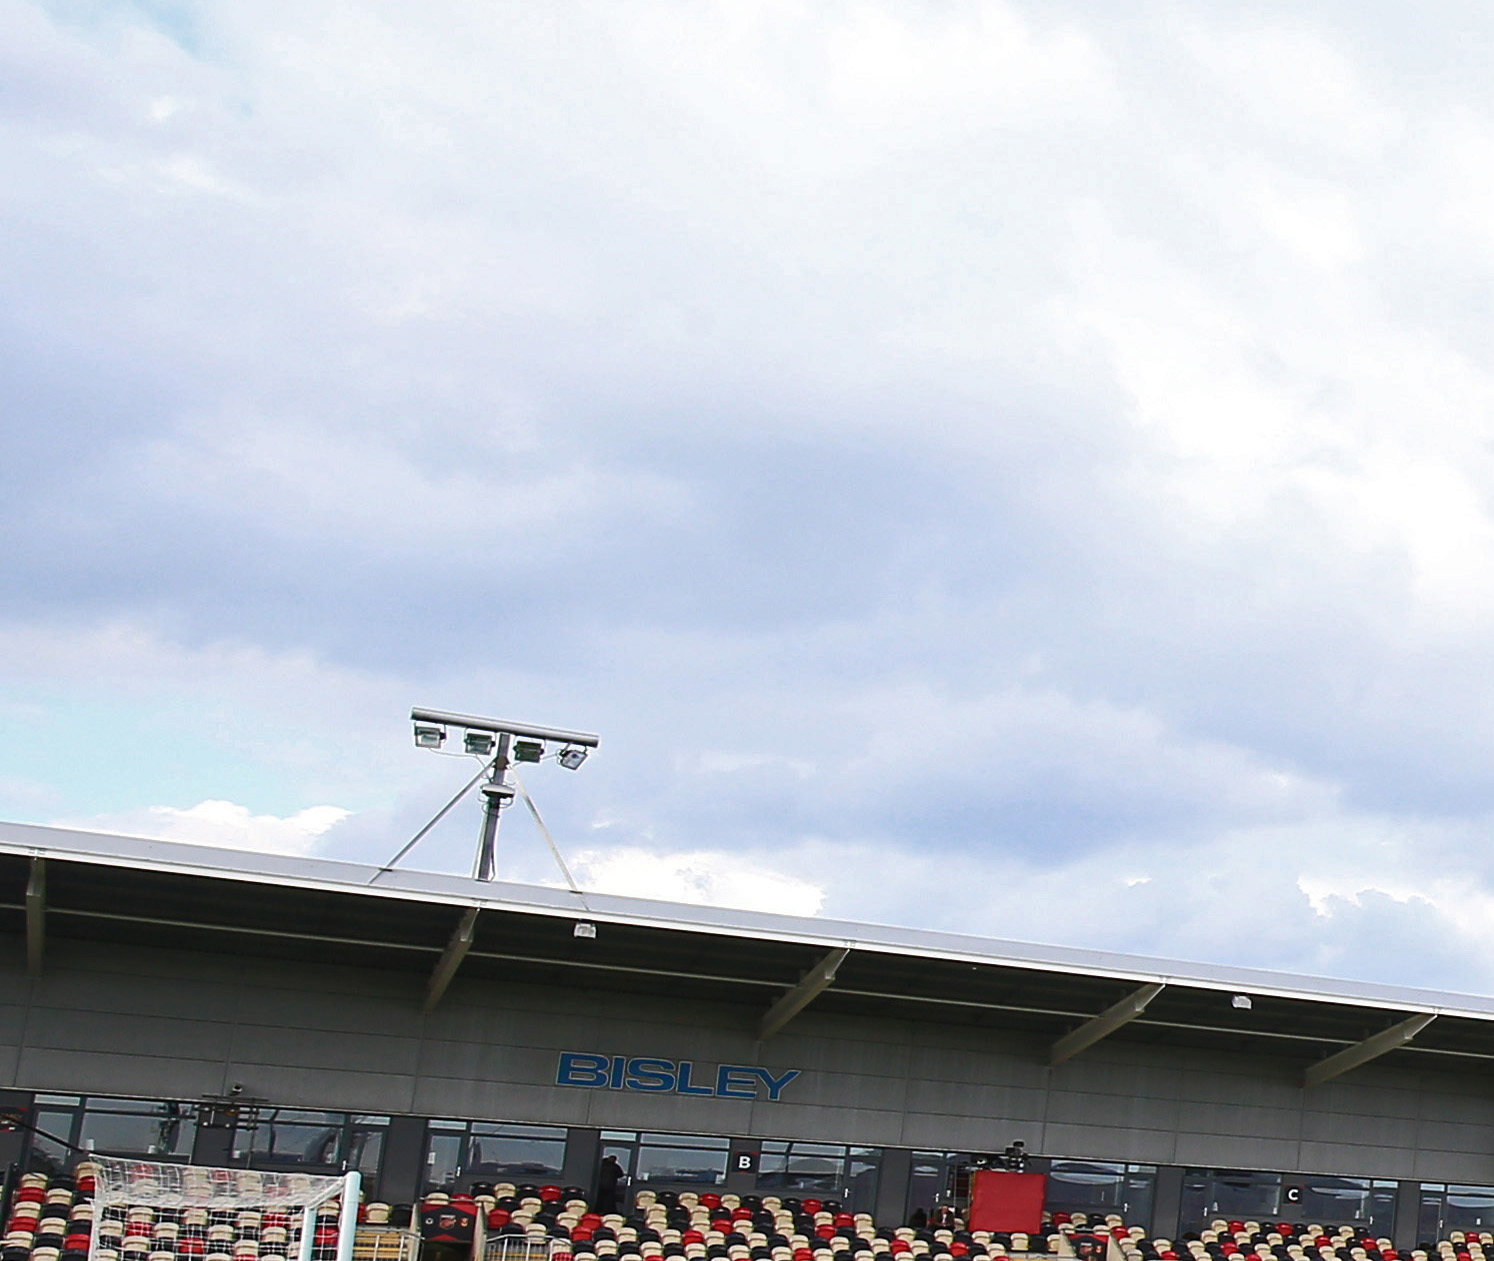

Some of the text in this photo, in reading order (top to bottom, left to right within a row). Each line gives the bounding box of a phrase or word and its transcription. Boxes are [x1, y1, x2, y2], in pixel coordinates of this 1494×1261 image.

[555, 1051, 801, 1101] BISLEY
[738, 1156, 751, 1170] B
[1288, 1189, 1299, 1201] C
